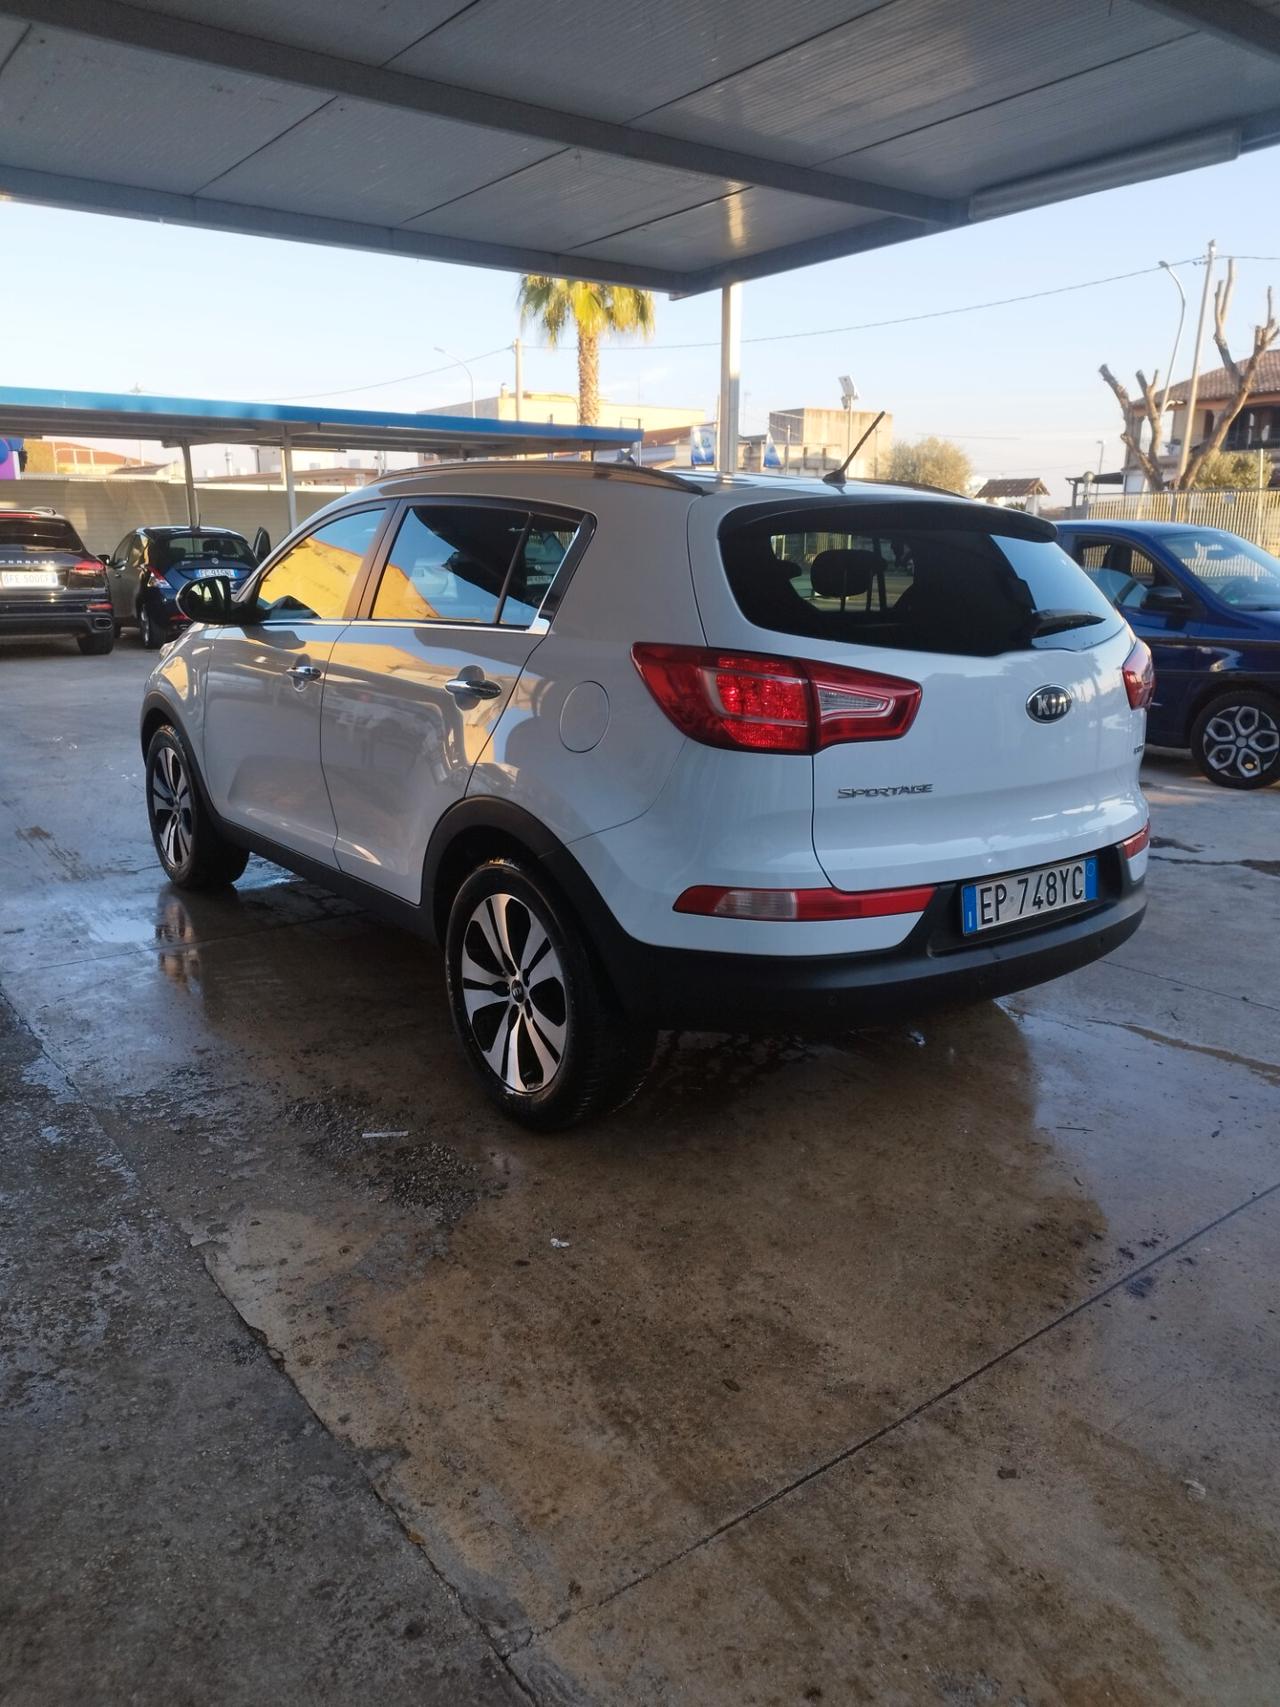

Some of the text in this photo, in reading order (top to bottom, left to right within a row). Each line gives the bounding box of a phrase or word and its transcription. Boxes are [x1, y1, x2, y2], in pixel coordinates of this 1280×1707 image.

[1036, 693, 1068, 716] KIA
[837, 784, 934, 799] SPORTAGE
[980, 865, 1083, 925] EP 748YC
